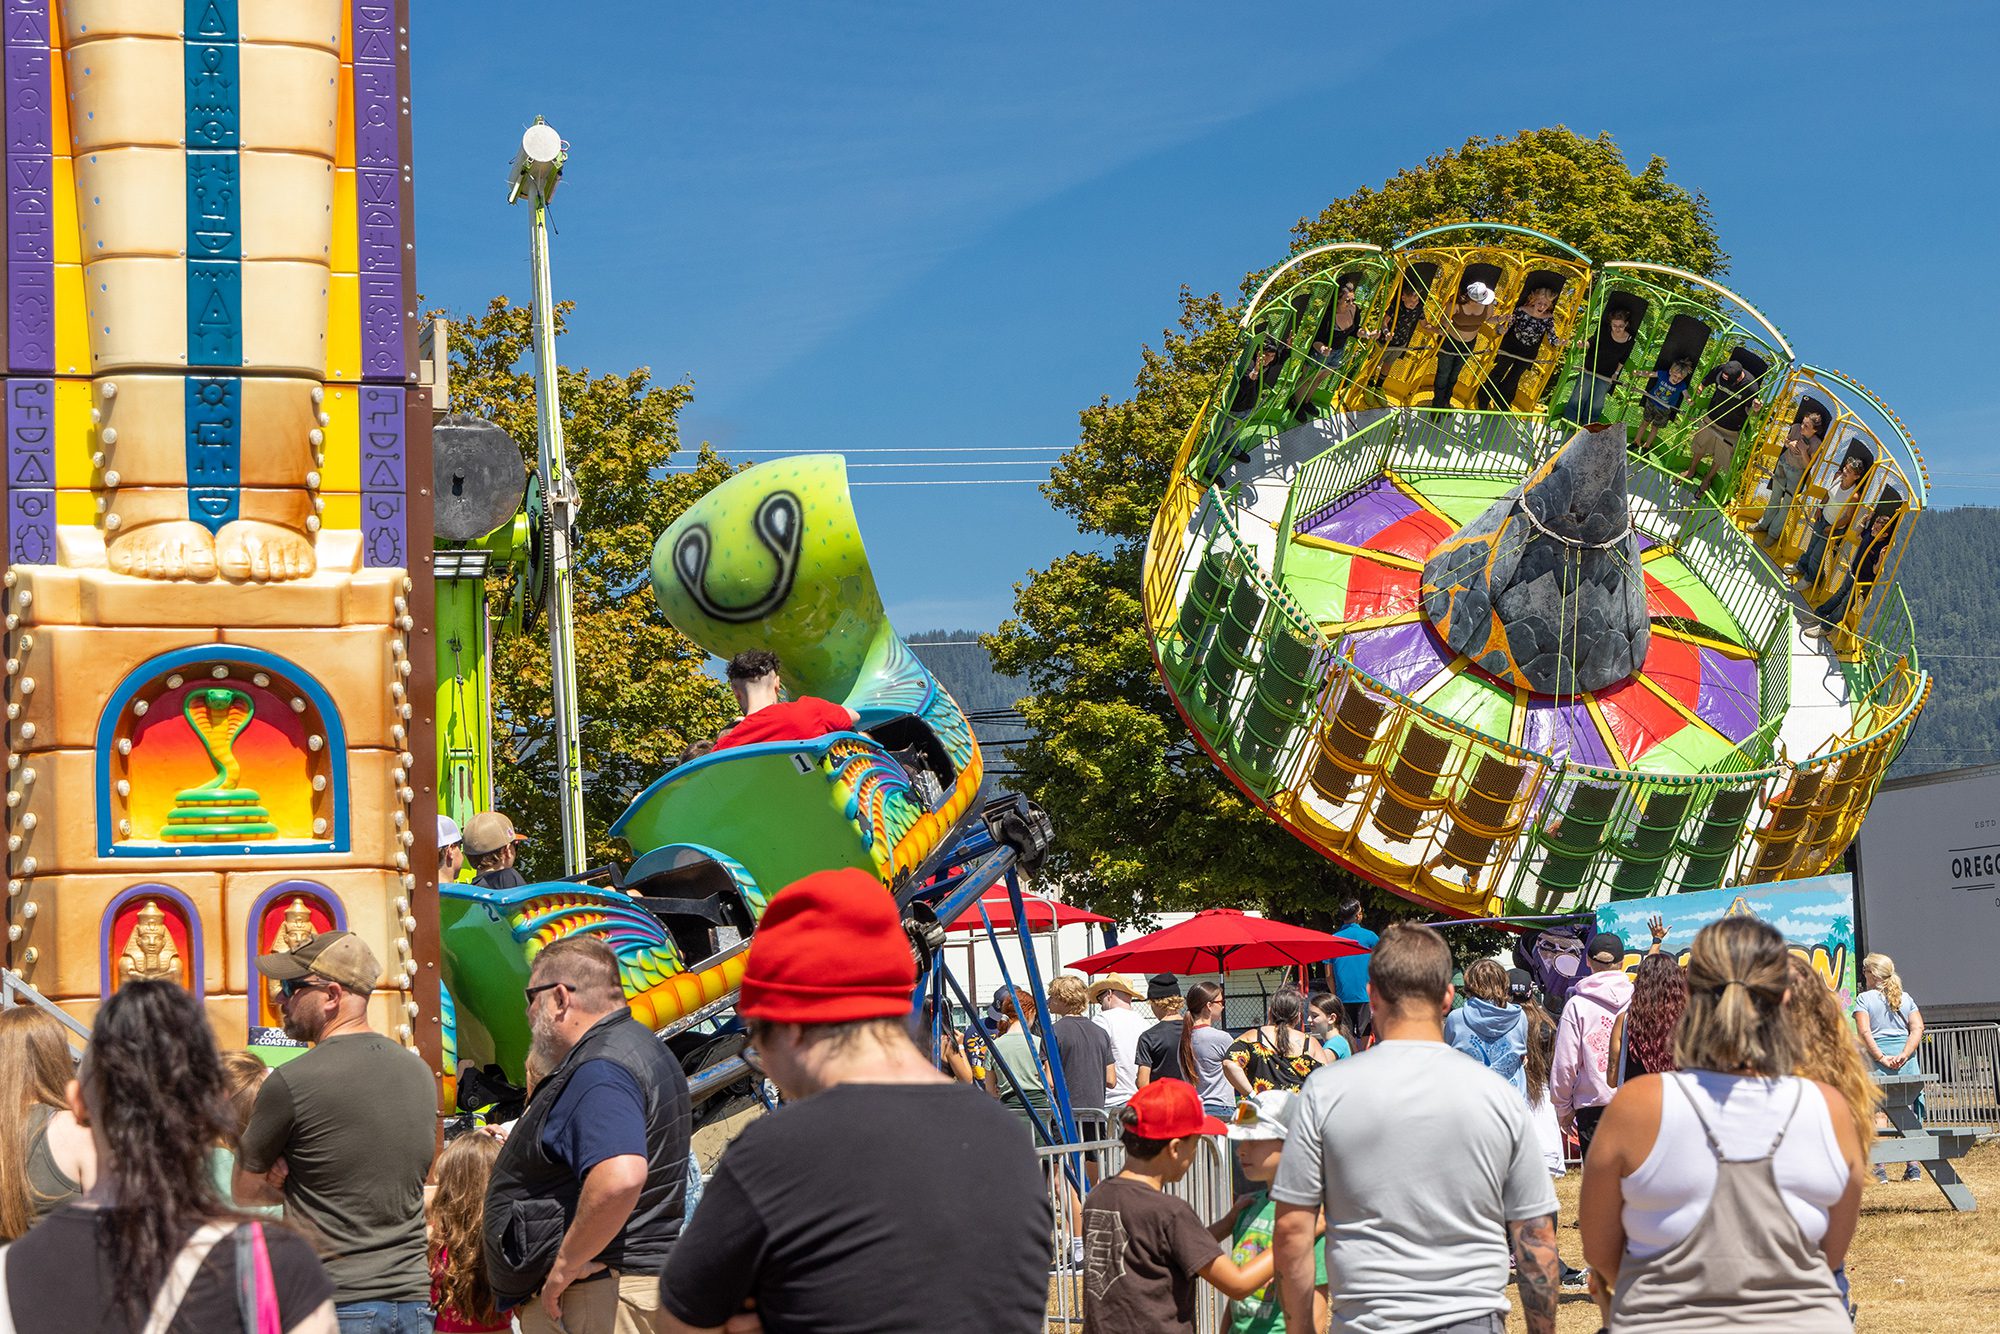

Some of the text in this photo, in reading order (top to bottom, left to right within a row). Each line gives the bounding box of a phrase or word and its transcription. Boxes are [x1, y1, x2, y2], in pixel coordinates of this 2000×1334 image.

[794, 754, 811, 773] 1
[1974, 819, 1997, 829] ESTD
[481, 902, 500, 922] 2
[259, 1038, 297, 1047] COASTER
